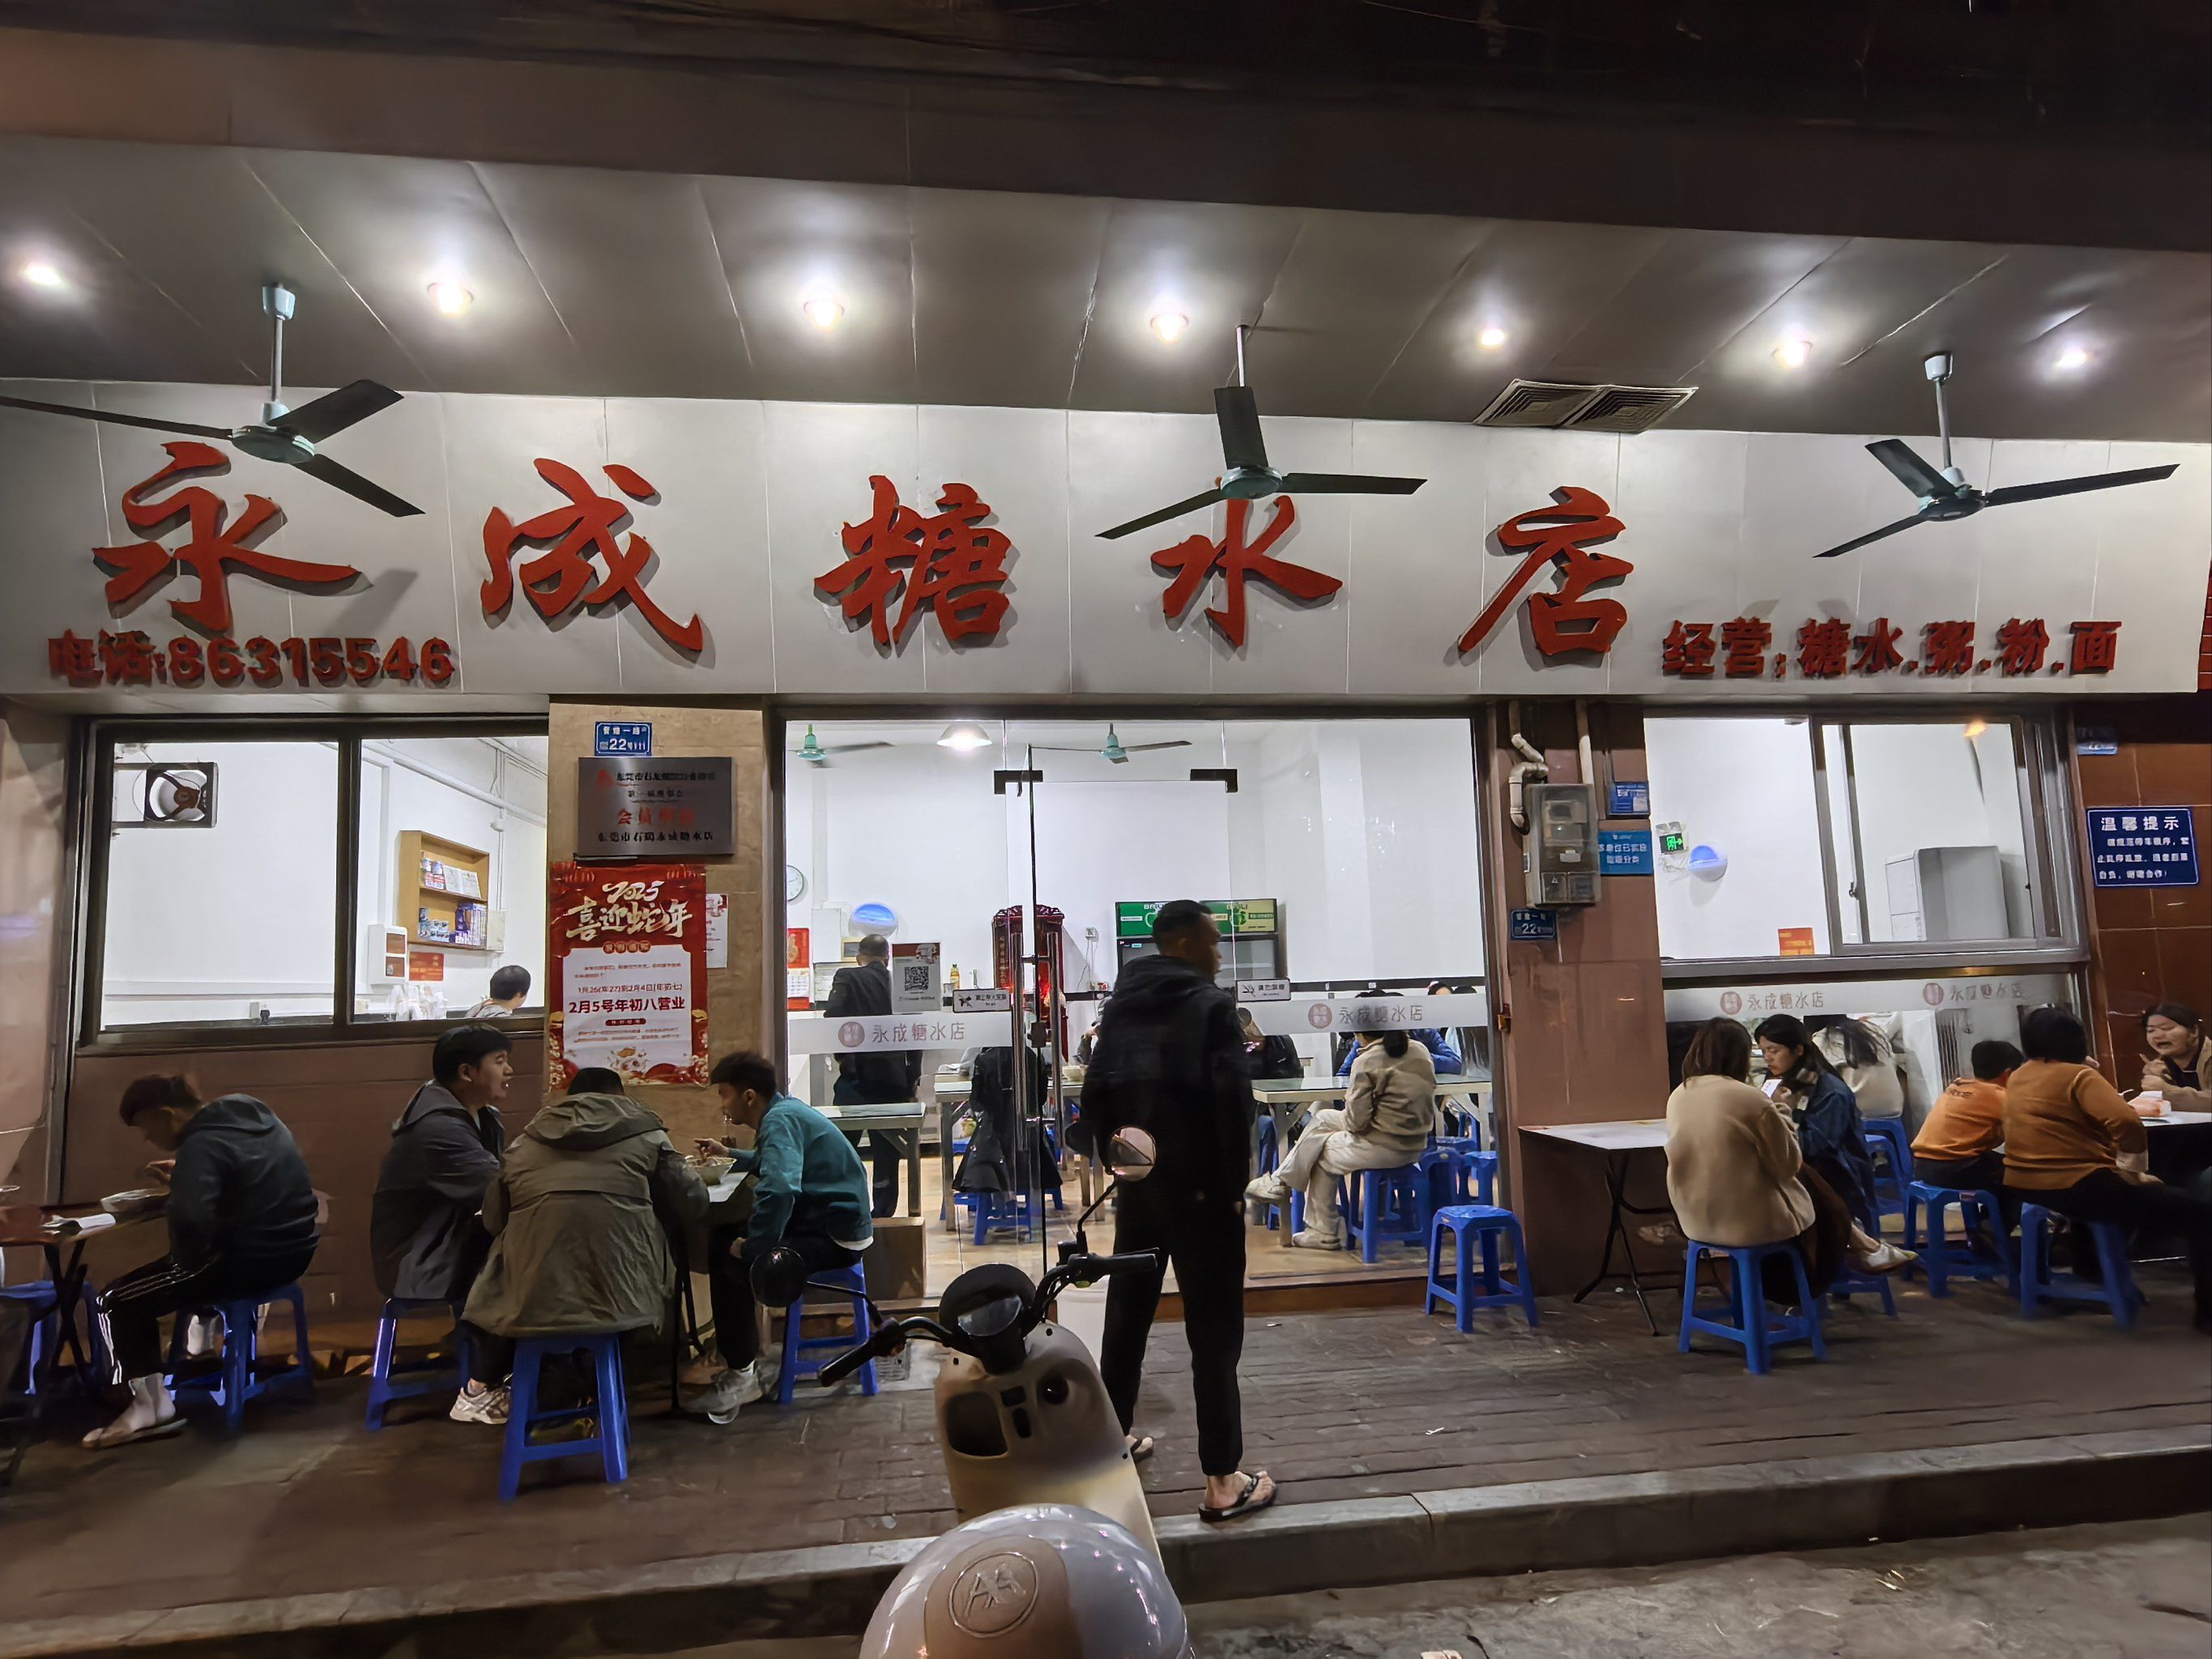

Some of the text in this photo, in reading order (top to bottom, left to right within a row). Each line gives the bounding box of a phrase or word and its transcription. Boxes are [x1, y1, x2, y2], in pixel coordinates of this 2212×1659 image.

[92, 441, 1634, 657] 永成糖水店
[2100, 816, 2180, 831] 温馨提示
[602, 881, 665, 903] 2025
[566, 895, 693, 941] 喜迎蛇年
[569, 996, 685, 1014] 2月5号年初八营业
[1748, 992, 1824, 1011] 永成糖水店
[872, 1021, 965, 1044] 永成糖水店
